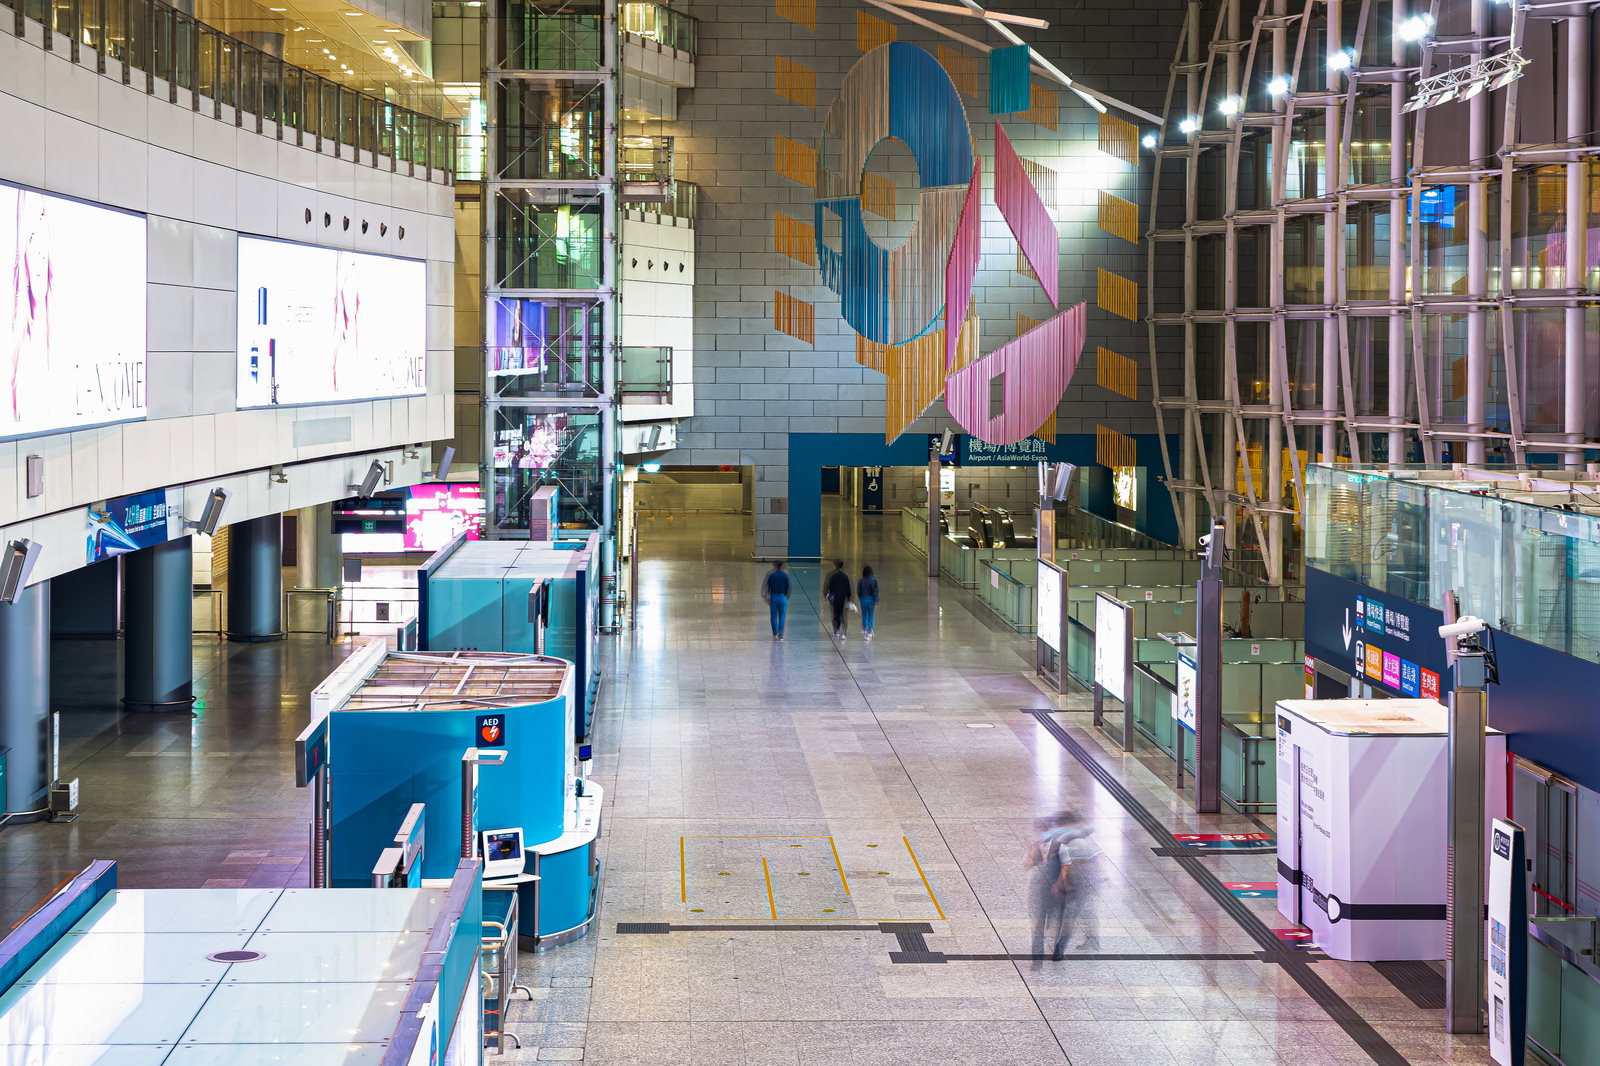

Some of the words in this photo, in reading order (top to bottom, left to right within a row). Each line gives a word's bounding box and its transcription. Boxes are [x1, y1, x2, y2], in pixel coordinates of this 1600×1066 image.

[968, 454, 992, 462] Airport
[997, 454, 1048, 462] AsiaWorld-Expo
[483, 718, 499, 726] AED
